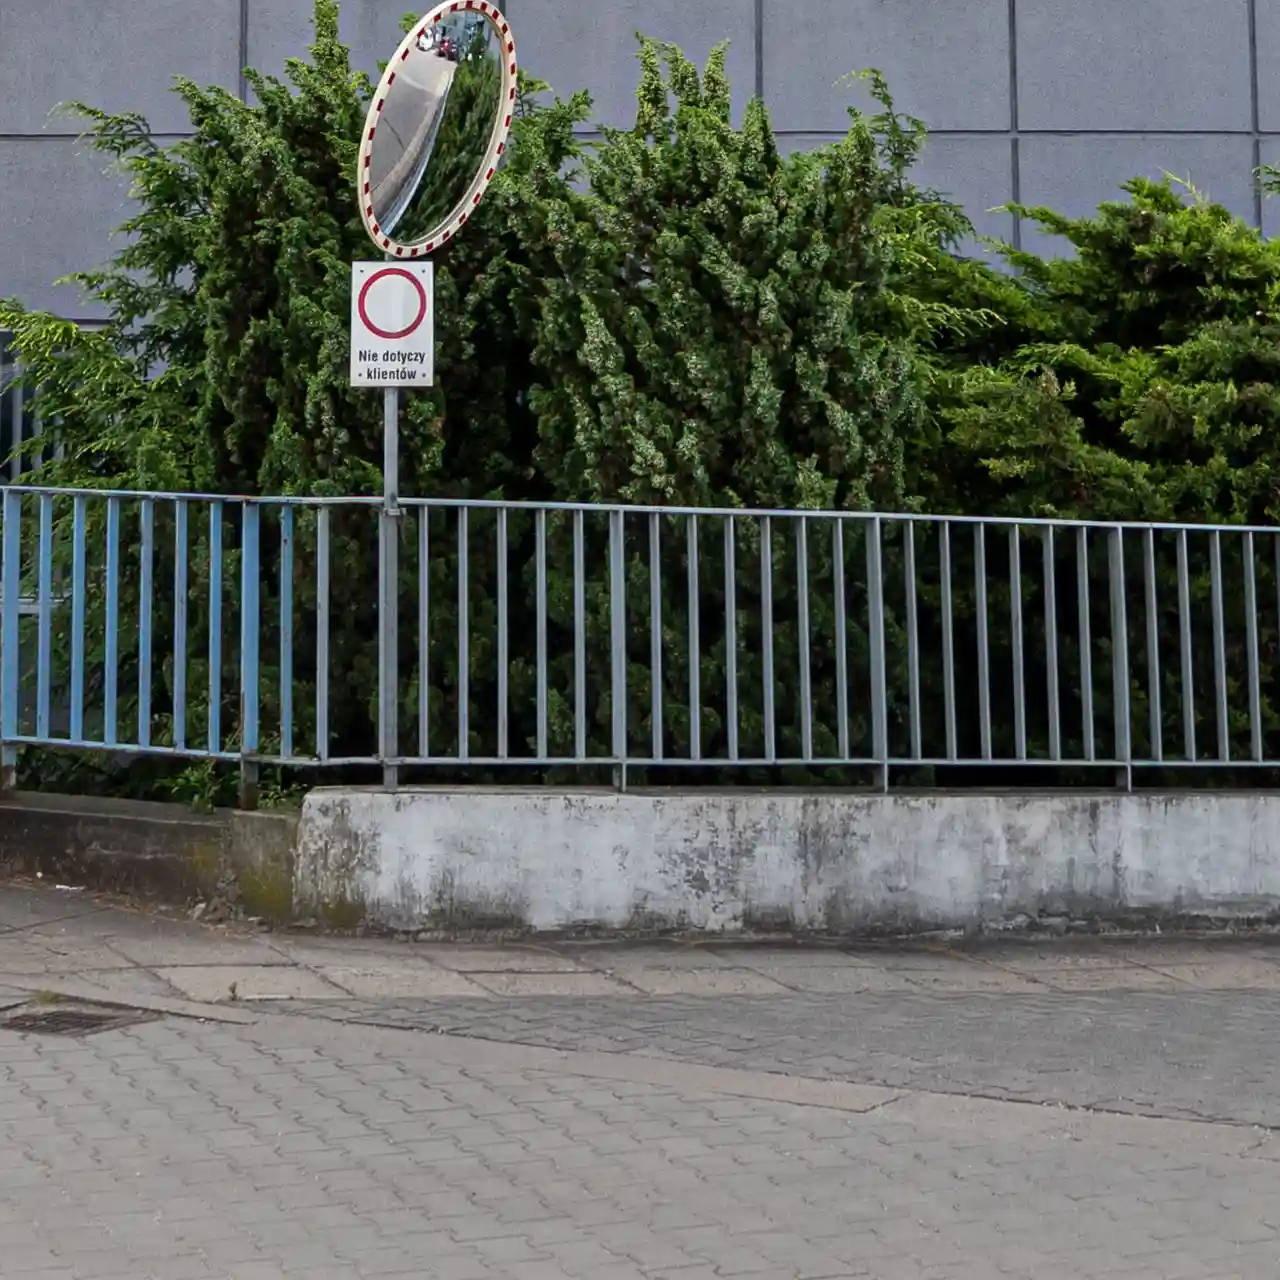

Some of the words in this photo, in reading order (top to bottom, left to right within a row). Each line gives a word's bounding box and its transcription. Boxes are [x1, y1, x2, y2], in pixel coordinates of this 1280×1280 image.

[358, 350, 379, 362] Nie
[382, 350, 426, 364] dotyczy
[366, 367, 417, 380] klientów
